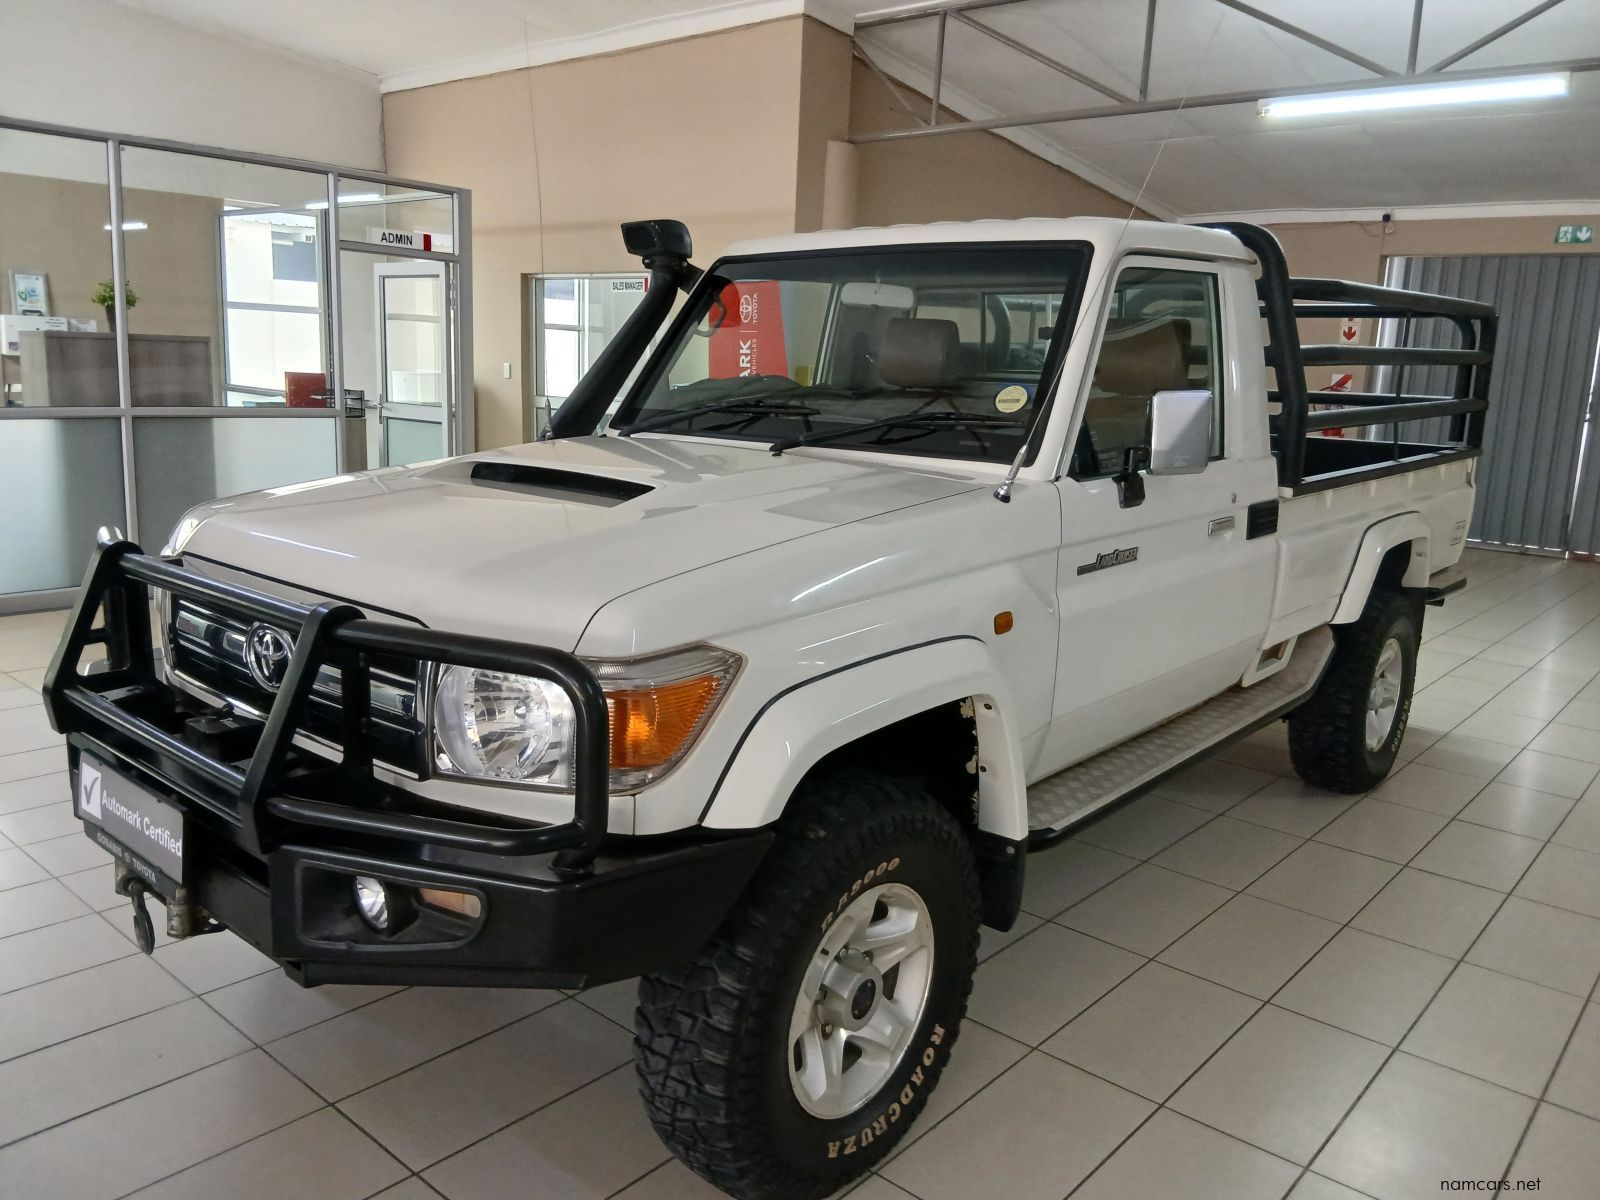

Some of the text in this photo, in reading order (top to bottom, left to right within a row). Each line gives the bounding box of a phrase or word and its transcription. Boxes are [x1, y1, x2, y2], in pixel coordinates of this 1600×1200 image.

[380, 231, 413, 246] ADMIN
[612, 281, 643, 291] SALES MANAGER
[101, 789, 183, 857] Automark Certified
[132, 857, 156, 883] TOYOTA
[827, 1023, 946, 1159] ROADCRUZA
